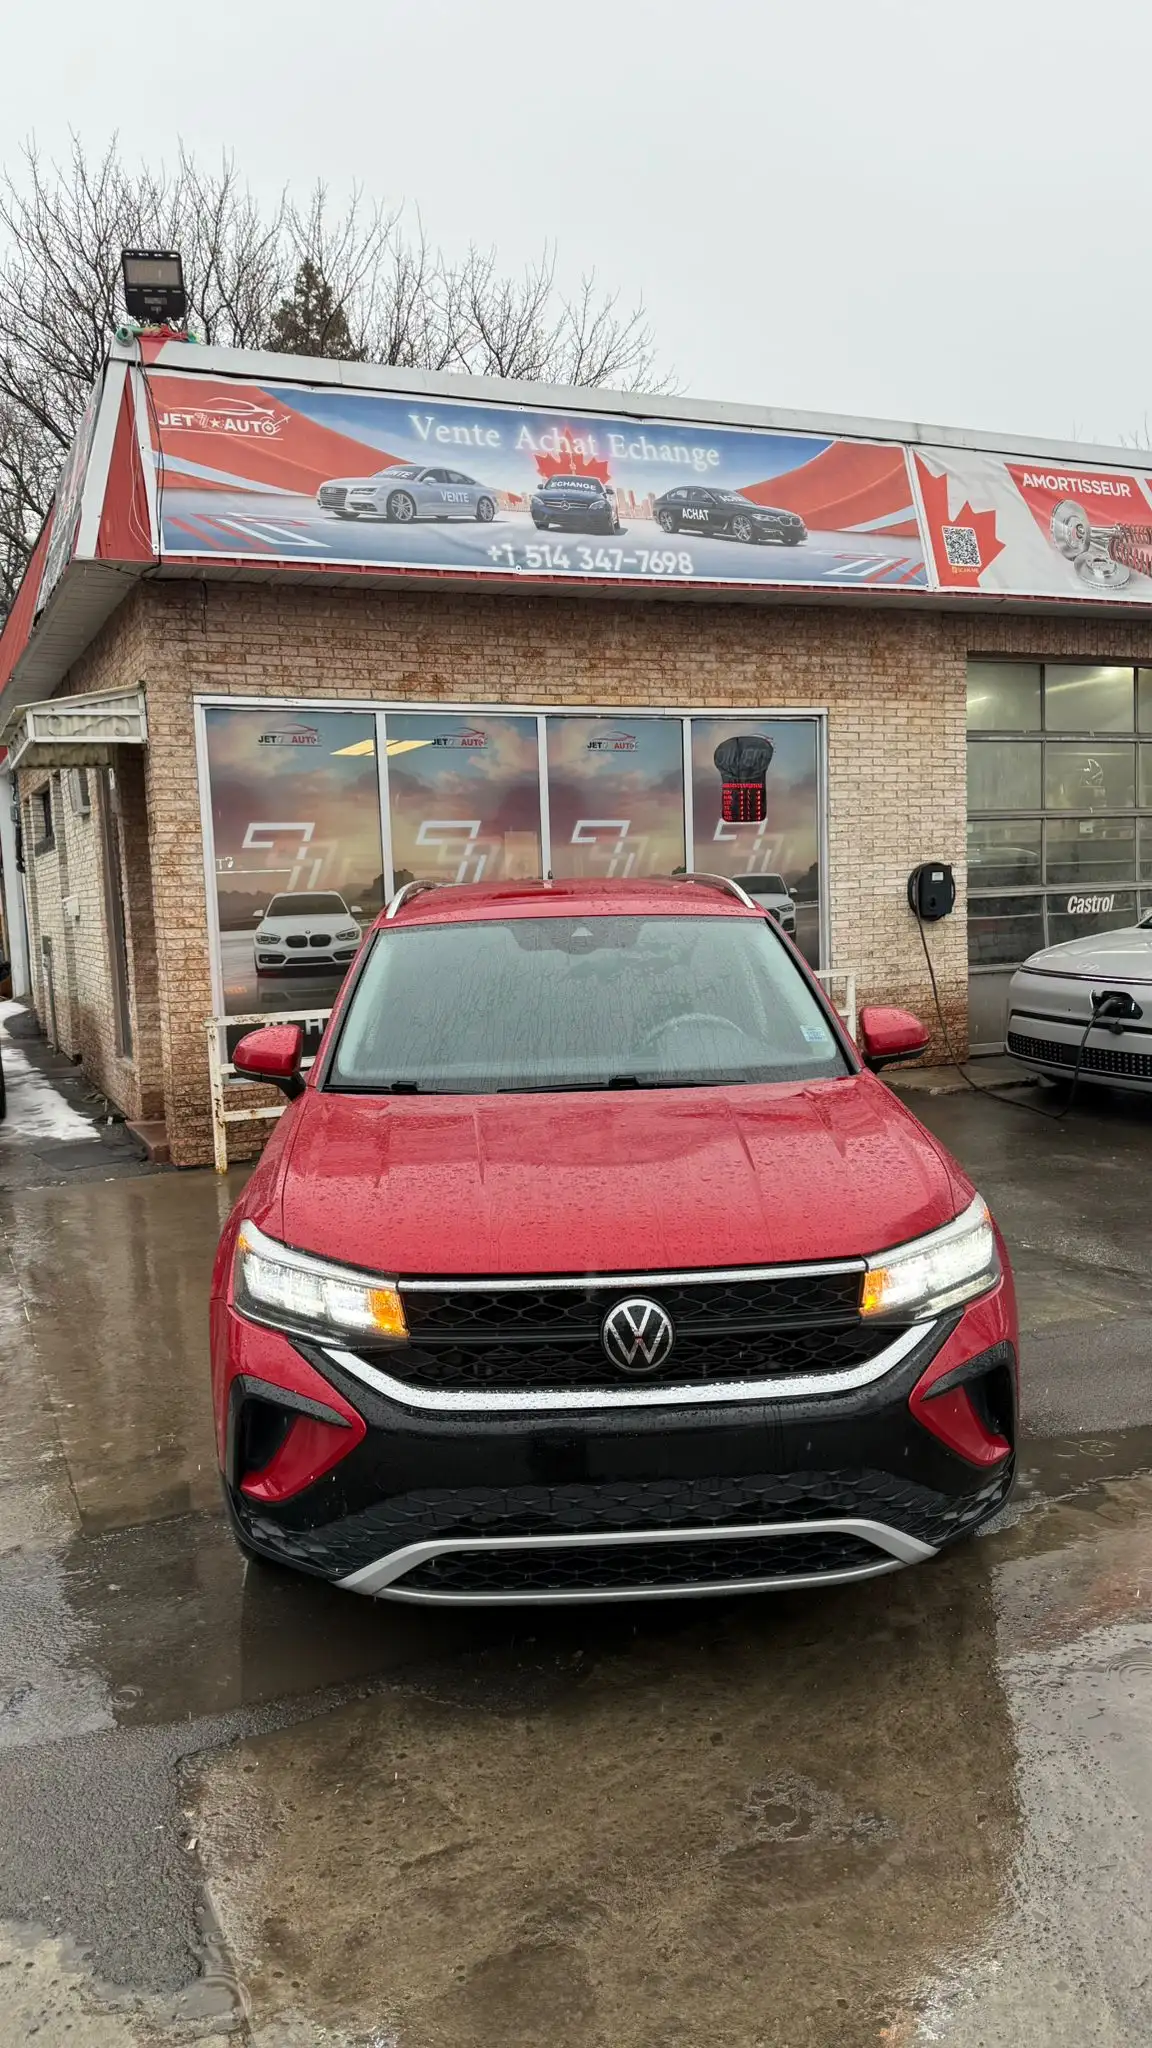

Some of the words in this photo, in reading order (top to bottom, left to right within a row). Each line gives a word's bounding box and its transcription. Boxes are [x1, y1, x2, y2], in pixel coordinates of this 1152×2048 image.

[158, 412, 194, 427] JET
[408, 414, 501, 448] Vente
[515, 425, 599, 456] Achat
[607, 433, 720, 472] Echange
[551, 481, 597, 491] ECHANGE
[1022, 472, 1132, 498] AMORTISSEUR
[441, 490, 469, 504] VENTE
[682, 508, 709, 521] ACHAT
[487, 543, 515, 567] +1
[524, 544, 571, 569] 514
[576, 546, 695, 575] 347-7698
[258, 735, 277, 744] JET
[431, 738, 448, 746] JET
[587, 741, 603, 749] JET
[1067, 894, 1115, 914] Castrol
